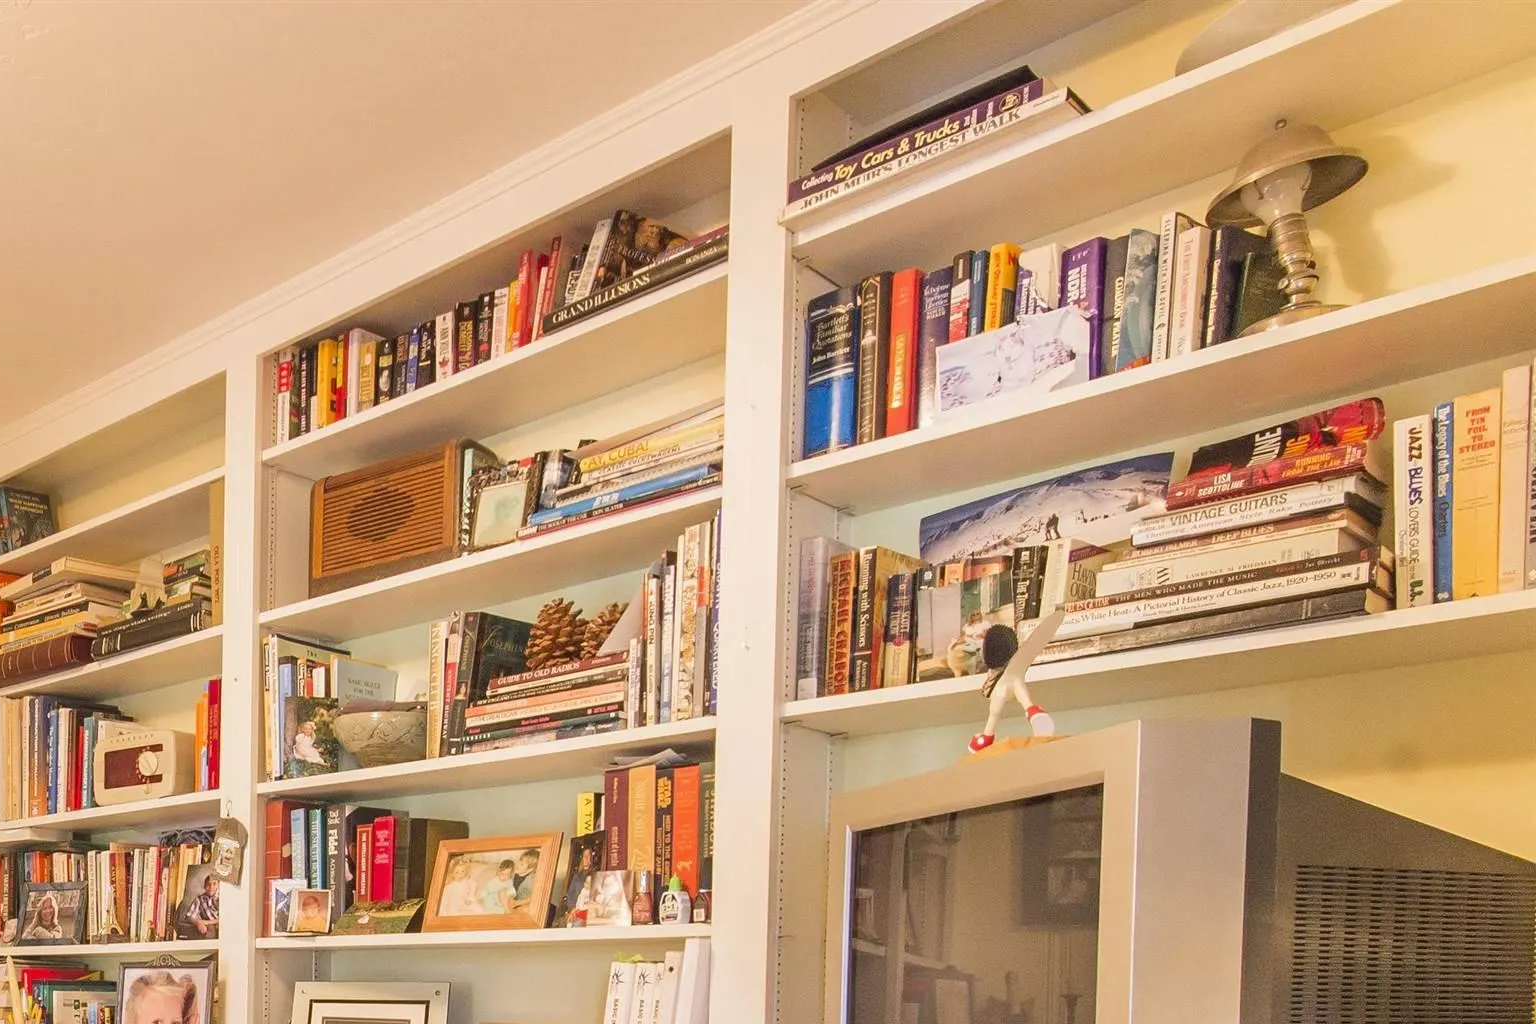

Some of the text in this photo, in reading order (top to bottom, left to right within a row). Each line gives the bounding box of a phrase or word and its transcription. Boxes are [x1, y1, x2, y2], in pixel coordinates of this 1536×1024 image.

[800, 109, 1022, 210] JOHN MUIR'S LONGEST WALK
[801, 119, 961, 190] Collecting Toy Cars & Trucks
[1162, 219, 1171, 255] SLEEPING
[552, 274, 651, 324] GRAND ILLUSIONS
[1159, 281, 1167, 294] THE
[1111, 276, 1124, 357] COMMON PRAYER
[1158, 296, 1166, 320] DEVIL
[827, 347, 850, 360] Bartlett
[1438, 405, 1451, 422] The
[1465, 406, 1491, 419] FROM
[1435, 421, 1449, 450] Legacy
[1467, 425, 1488, 436] FOIL
[1471, 434, 1484, 443] TO
[608, 439, 649, 460] CUBA!
[1408, 426, 1423, 462] JAZZ
[1437, 449, 1450, 460] of
[1458, 440, 1496, 454] STEREO
[1281, 459, 1344, 478] FROM THE LAW
[1295, 453, 1331, 468] RUNNING
[1437, 461, 1450, 473] the
[1197, 480, 1246, 498] SCOTTOLINE
[1213, 473, 1232, 485] LISA
[1406, 467, 1423, 506] BLUES
[1437, 473, 1450, 497] Blues
[1170, 507, 1226, 527] VINTAGE
[1229, 492, 1288, 515] GUITARS
[1191, 516, 1233, 533] American
[1239, 512, 1262, 522] Style
[1298, 498, 1333, 509] Pottery
[1408, 538, 1419, 564] GUIDE
[1185, 559, 1278, 580] LAWRENCE FRIEDMAN
[1115, 595, 1131, 603] THE
[1134, 591, 1152, 600] MEN
[1155, 586, 1177, 595] WHO
[1179, 582, 1205, 591] MADE
[1207, 578, 1224, 586] THE
[1227, 572, 1258, 583] MUSIC
[859, 552, 873, 648] Running with Scissors
[1081, 611, 1107, 623] White
[1135, 604, 1142, 612] A
[1143, 598, 1180, 611] Pictorial
[1181, 593, 1214, 605] History
[1216, 589, 1225, 598] of
[1227, 584, 1258, 596] Classic
[1259, 580, 1285, 592] Jazz,
[833, 560, 852, 695] MICHAEL CHABON
[900, 610, 910, 633] SCOTT
[497, 661, 581, 686] GUIDE TO OLD RADIOS
[657, 776, 665, 809] WARS
[664, 778, 672, 807] STAR
[328, 828, 338, 856] Fidel
[612, 998, 620, 1019] BASIC
[637, 999, 645, 1020] BASIC
